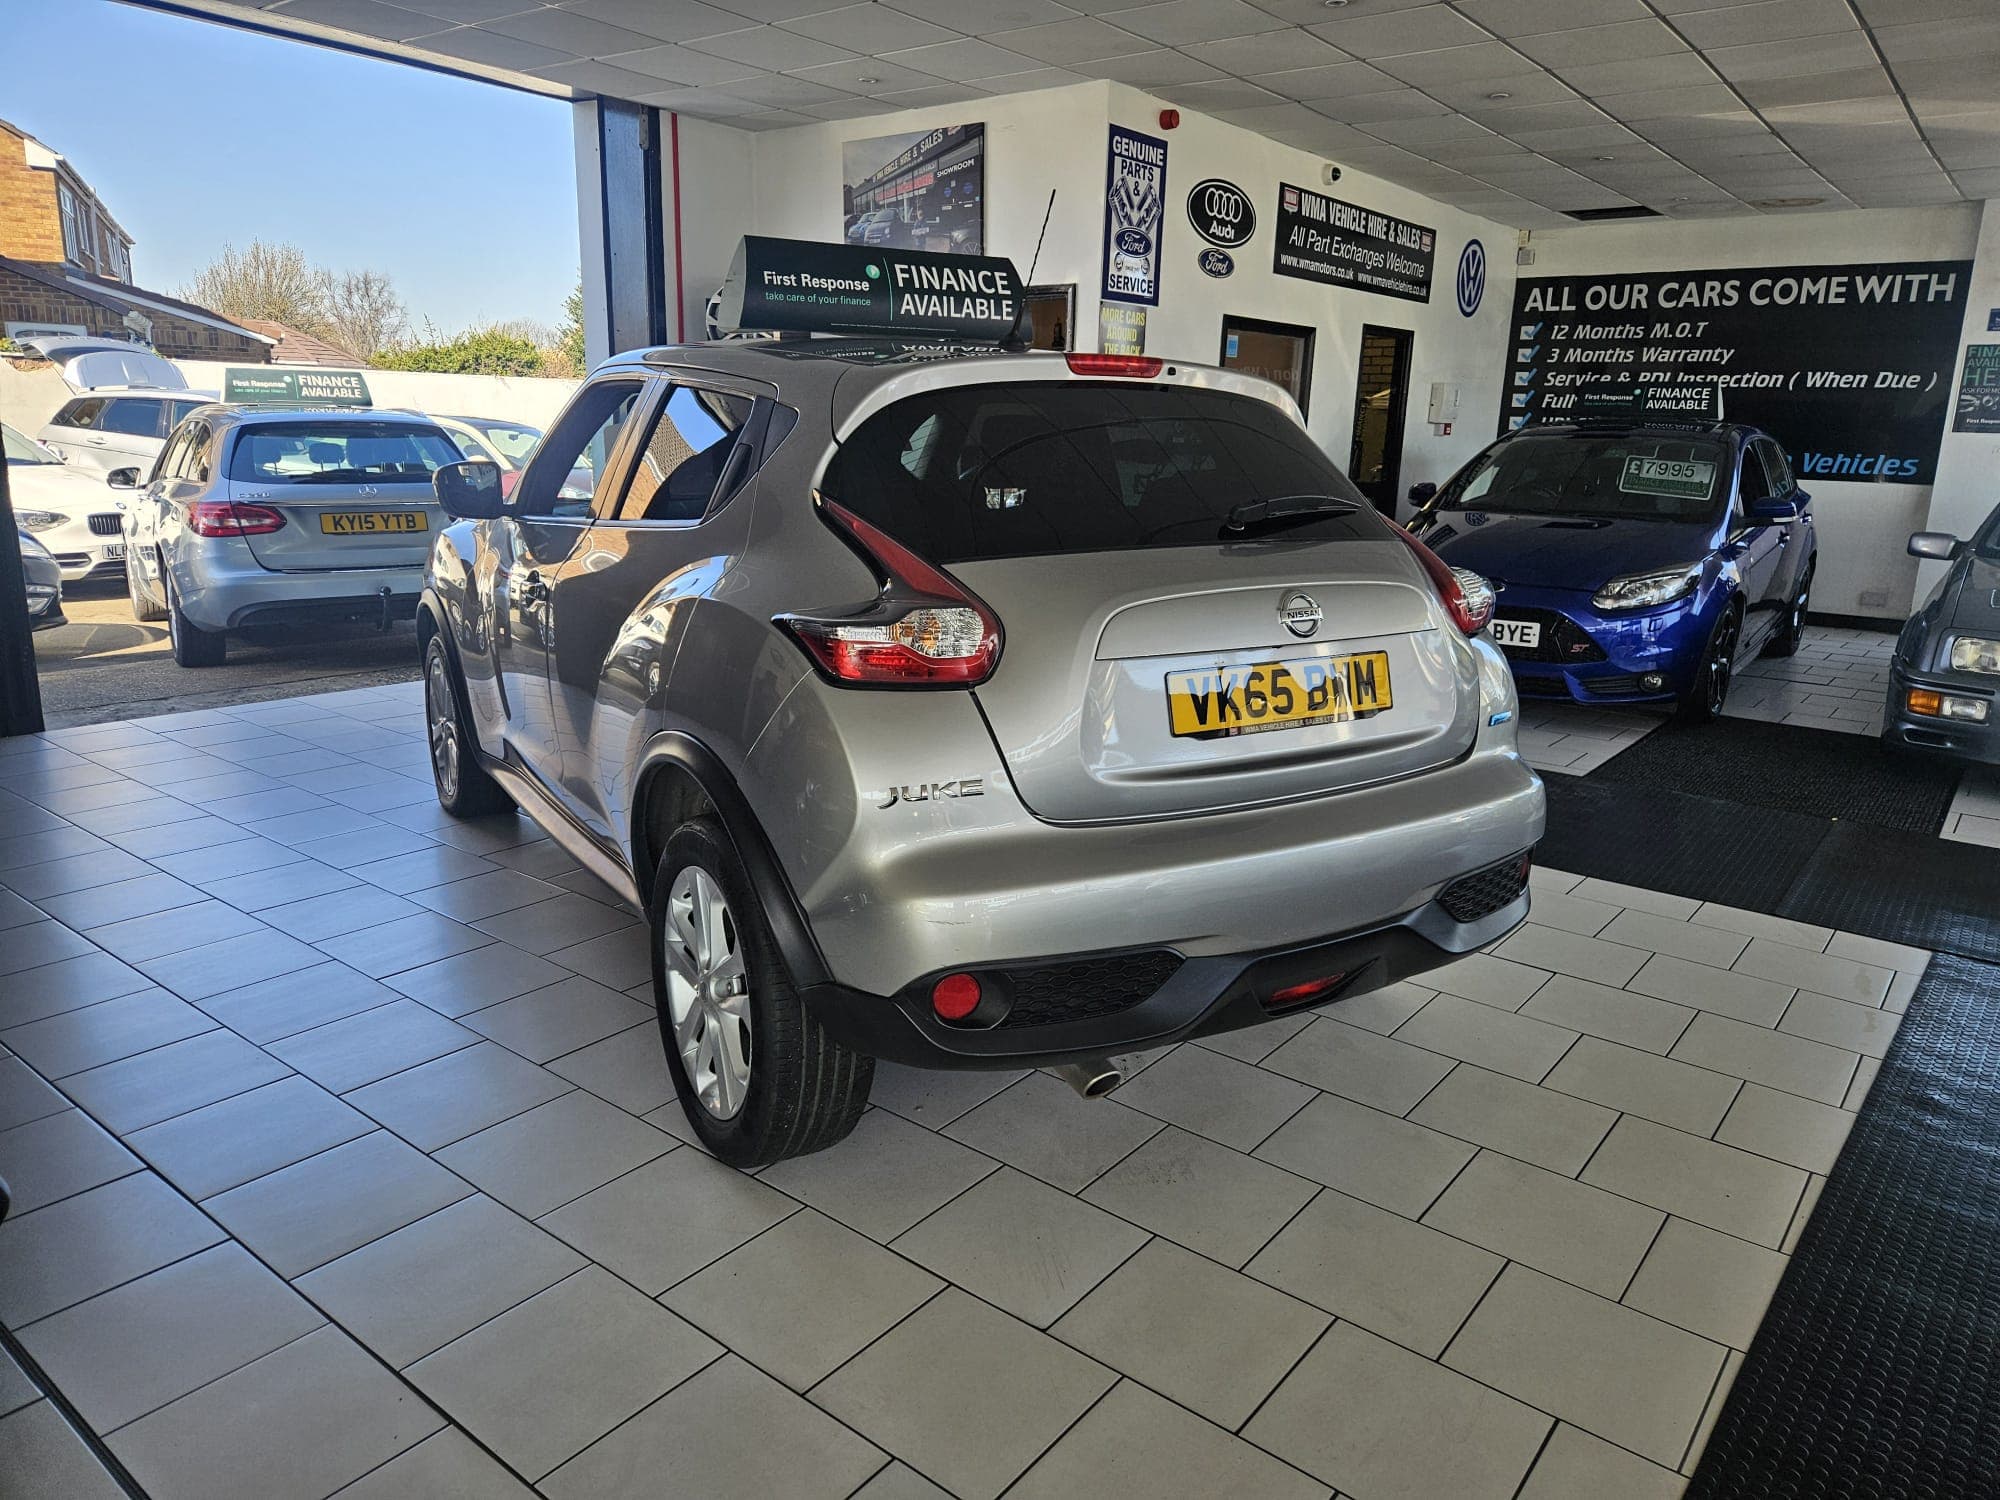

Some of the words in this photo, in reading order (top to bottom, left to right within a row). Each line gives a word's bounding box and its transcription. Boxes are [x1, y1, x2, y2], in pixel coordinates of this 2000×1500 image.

[920, 129, 943, 153] SALES
[1113, 136, 1164, 166] GENUINE
[937, 159, 975, 178] SHOWROOM
[1121, 159, 1154, 182] PARTS
[1132, 180, 1141, 197] &
[1209, 220, 1235, 240] Audi
[1301, 192, 1327, 223] WMA
[1329, 201, 1366, 234] VEHICLE
[1367, 214, 1387, 240] HIRE
[1388, 221, 1395, 242] &
[1397, 223, 1421, 250] SALES
[1121, 231, 1146, 253] Ford
[1288, 224, 1304, 247] All
[1307, 229, 1330, 254] Part
[1331, 236, 1385, 270] Exchanges
[1386, 251, 1425, 278] Welcome
[1205, 251, 1229, 274] Ford
[763, 270, 796, 287] First
[801, 272, 870, 294] Response
[894, 263, 1012, 295] FINANCE
[1109, 273, 1153, 295] SERVICE
[1280, 253, 1354, 281] www.wmamotors.co.uk
[1357, 271, 1427, 297] www.wmavehiclehire.co.uk
[765, 291, 786, 302] take
[787, 294, 806, 303] care
[807, 292, 817, 303] of
[818, 295, 838, 306] your
[839, 294, 871, 306] finance
[1524, 286, 1577, 312] ALL
[1584, 283, 1649, 311] OUR
[1657, 279, 1740, 309] CARS
[1749, 276, 1849, 306] COME
[1855, 272, 1957, 304] WITH
[900, 292, 1014, 321] AVAILABLE
[1102, 307, 1125, 323] MORE
[1126, 310, 1146, 326] CARS
[1106, 325, 1137, 342] AROUND
[1550, 325, 1567, 340] 12
[1573, 323, 1645, 340] Months
[1650, 321, 1709, 339] M.O.T
[1547, 348, 1558, 362] 3
[1564, 346, 1635, 363] Months
[1642, 347, 1735, 365] Warranty
[297, 375, 360, 388] FINANCE
[1806, 371, 1872, 389] When
[1874, 371, 1921, 389] Due
[301, 387, 362, 398] AVAILABLE
[1541, 393, 1578, 409] Full
[1601, 393, 1634, 401] Response
[1647, 387, 1712, 399] FINANCE
[1645, 399, 1709, 410] AVAILABLE
[1802, 453, 1920, 476] Vehicles
[333, 514, 375, 531] KY15
[379, 513, 417, 530] YTB
[1287, 609, 1320, 619] NISSAN
[1493, 623, 1533, 643] BYE
[1570, 644, 1590, 653] ST
[1186, 668, 1295, 726] VK65
[1260, 722, 1285, 732] VEHICLE
[876, 779, 984, 810] JUKE
